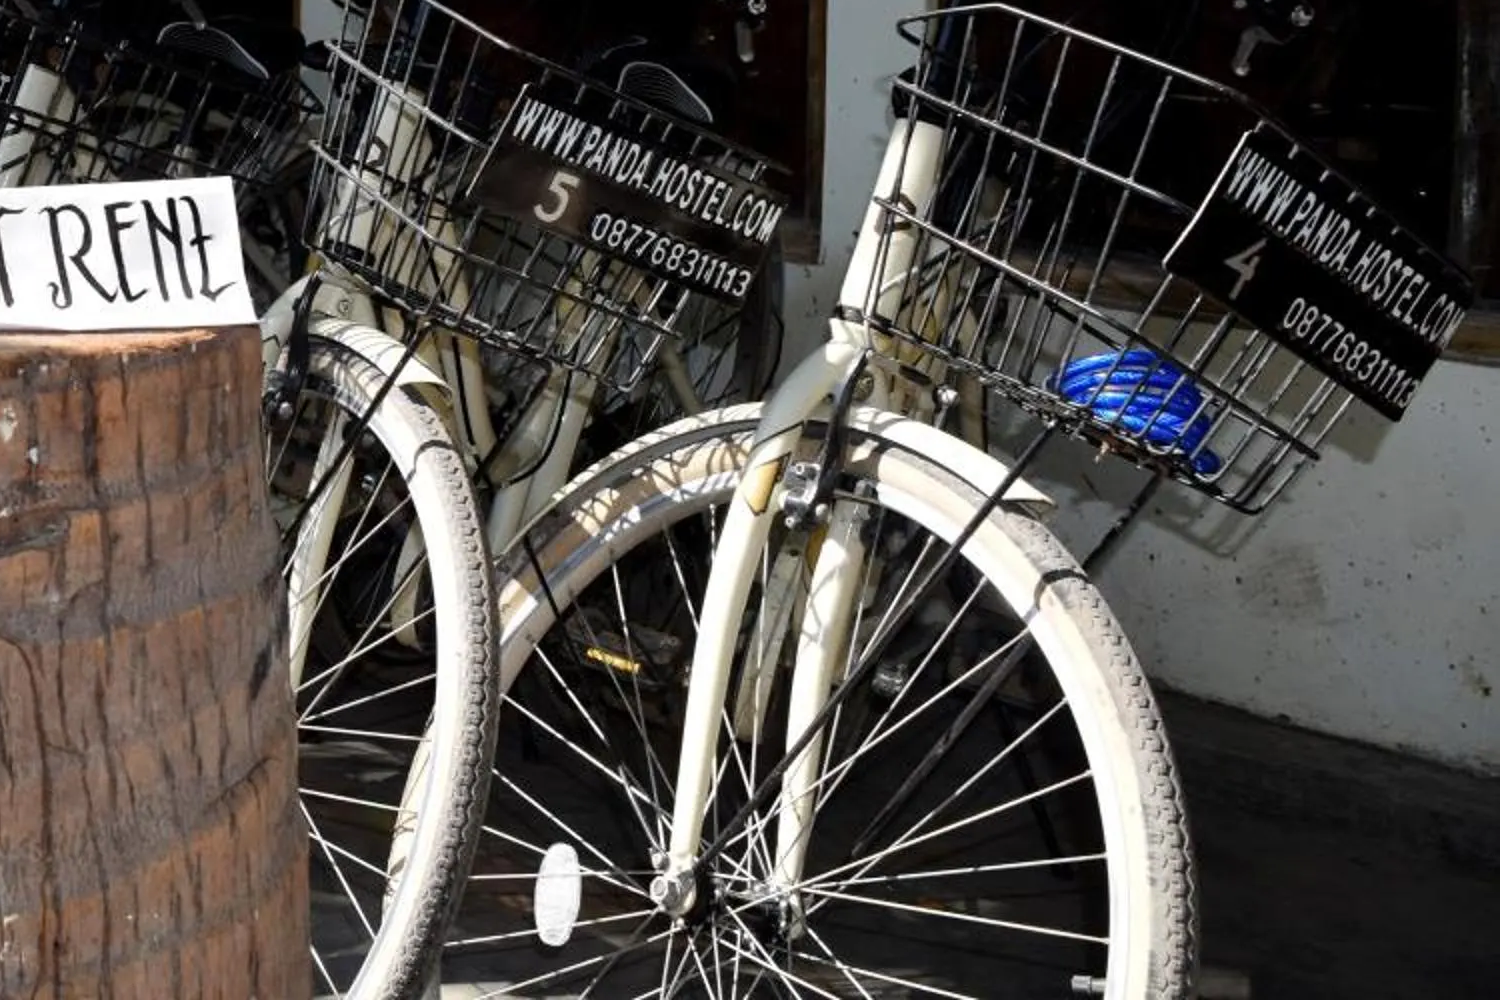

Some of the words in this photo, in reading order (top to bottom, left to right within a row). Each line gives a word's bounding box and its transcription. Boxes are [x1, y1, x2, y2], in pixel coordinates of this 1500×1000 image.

[533, 170, 581, 223] 5
[590, 212, 753, 298] 087768311113
[1223, 237, 1269, 300] 4
